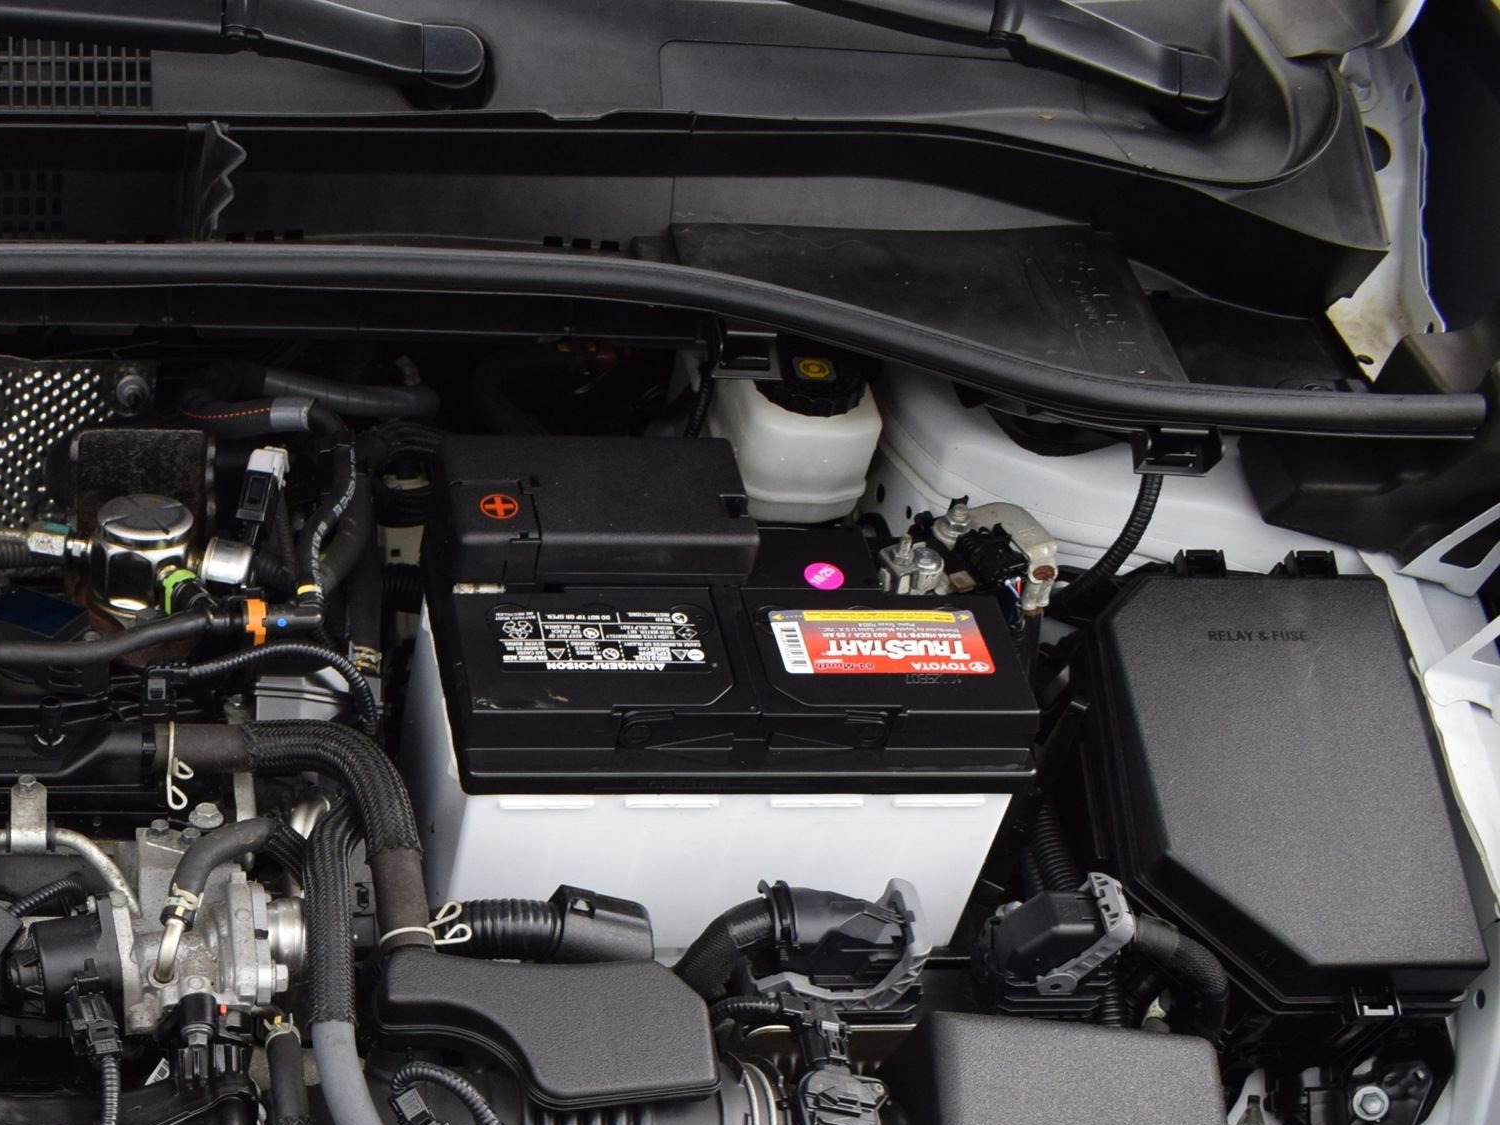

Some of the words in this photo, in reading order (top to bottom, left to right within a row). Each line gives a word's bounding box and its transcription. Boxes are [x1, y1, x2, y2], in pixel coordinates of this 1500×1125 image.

[811, 566, 836, 585] 10/25
[1207, 630, 1253, 641] RELAY
[1259, 631, 1268, 641] &
[1272, 631, 1308, 641] FUSE
[546, 662, 655, 670] DANGER/POISON
[911, 662, 969, 670] TOYOTA
